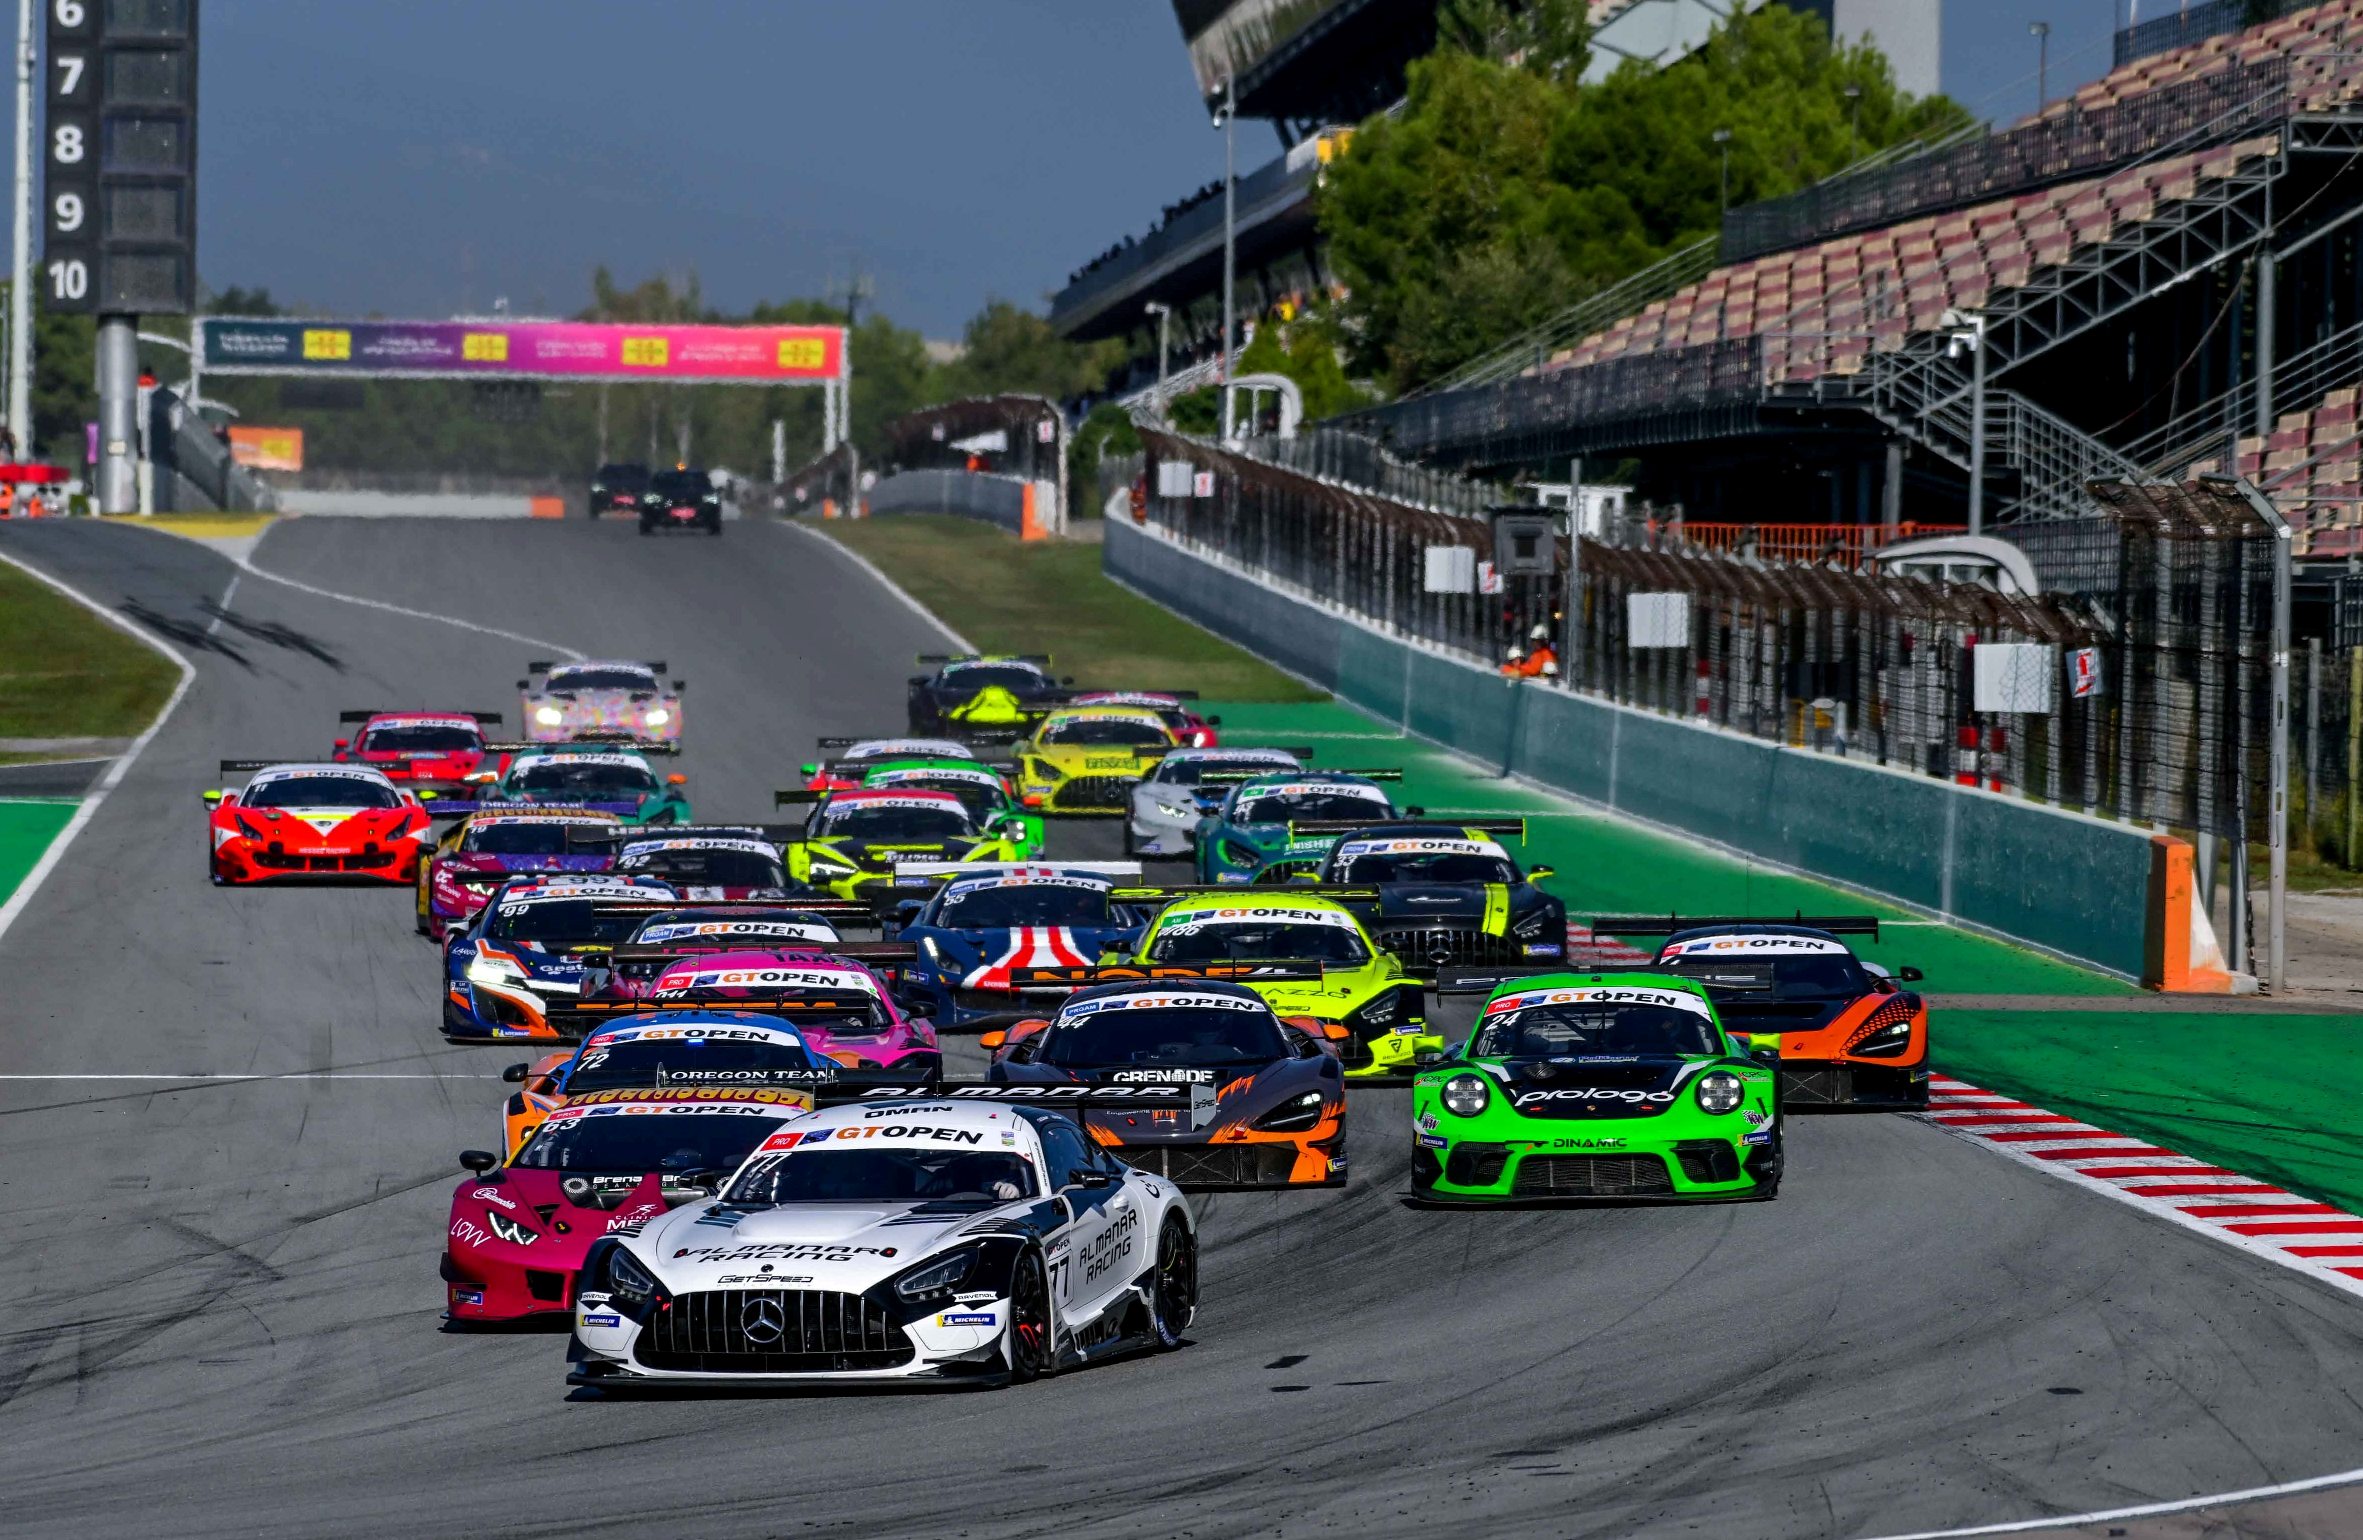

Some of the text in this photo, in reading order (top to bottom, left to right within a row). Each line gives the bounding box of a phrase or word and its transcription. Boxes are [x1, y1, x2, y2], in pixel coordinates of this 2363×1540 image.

[56, 0, 84, 27] 6
[57, 57, 84, 94] 7
[54, 125, 84, 163] 8
[55, 193, 84, 232] 9
[49, 261, 87, 299] 10
[503, 905, 530, 917] 99
[667, 978, 684, 986] PRO
[1485, 1011, 1522, 1031] 24
[593, 1035, 611, 1043] PRO
[577, 1054, 609, 1071] 72
[671, 1071, 768, 1079] OREGON
[1514, 1087, 1675, 1107] prologo
[864, 1106, 953, 1119] OMAN
[542, 1119, 581, 1132] 63
[772, 1125, 984, 1146] PRO GTOPEN
[1553, 1138, 1628, 1148] DINAMIC
[1079, 1208, 1138, 1268] ALMANAR
[697, 1251, 855, 1263] RACING
[1086, 1236, 1131, 1285] RACING
[1048, 1254, 1070, 1298] 77
[588, 1317, 616, 1325] MICHELIN
[954, 1316, 990, 1324] MICHELIN
